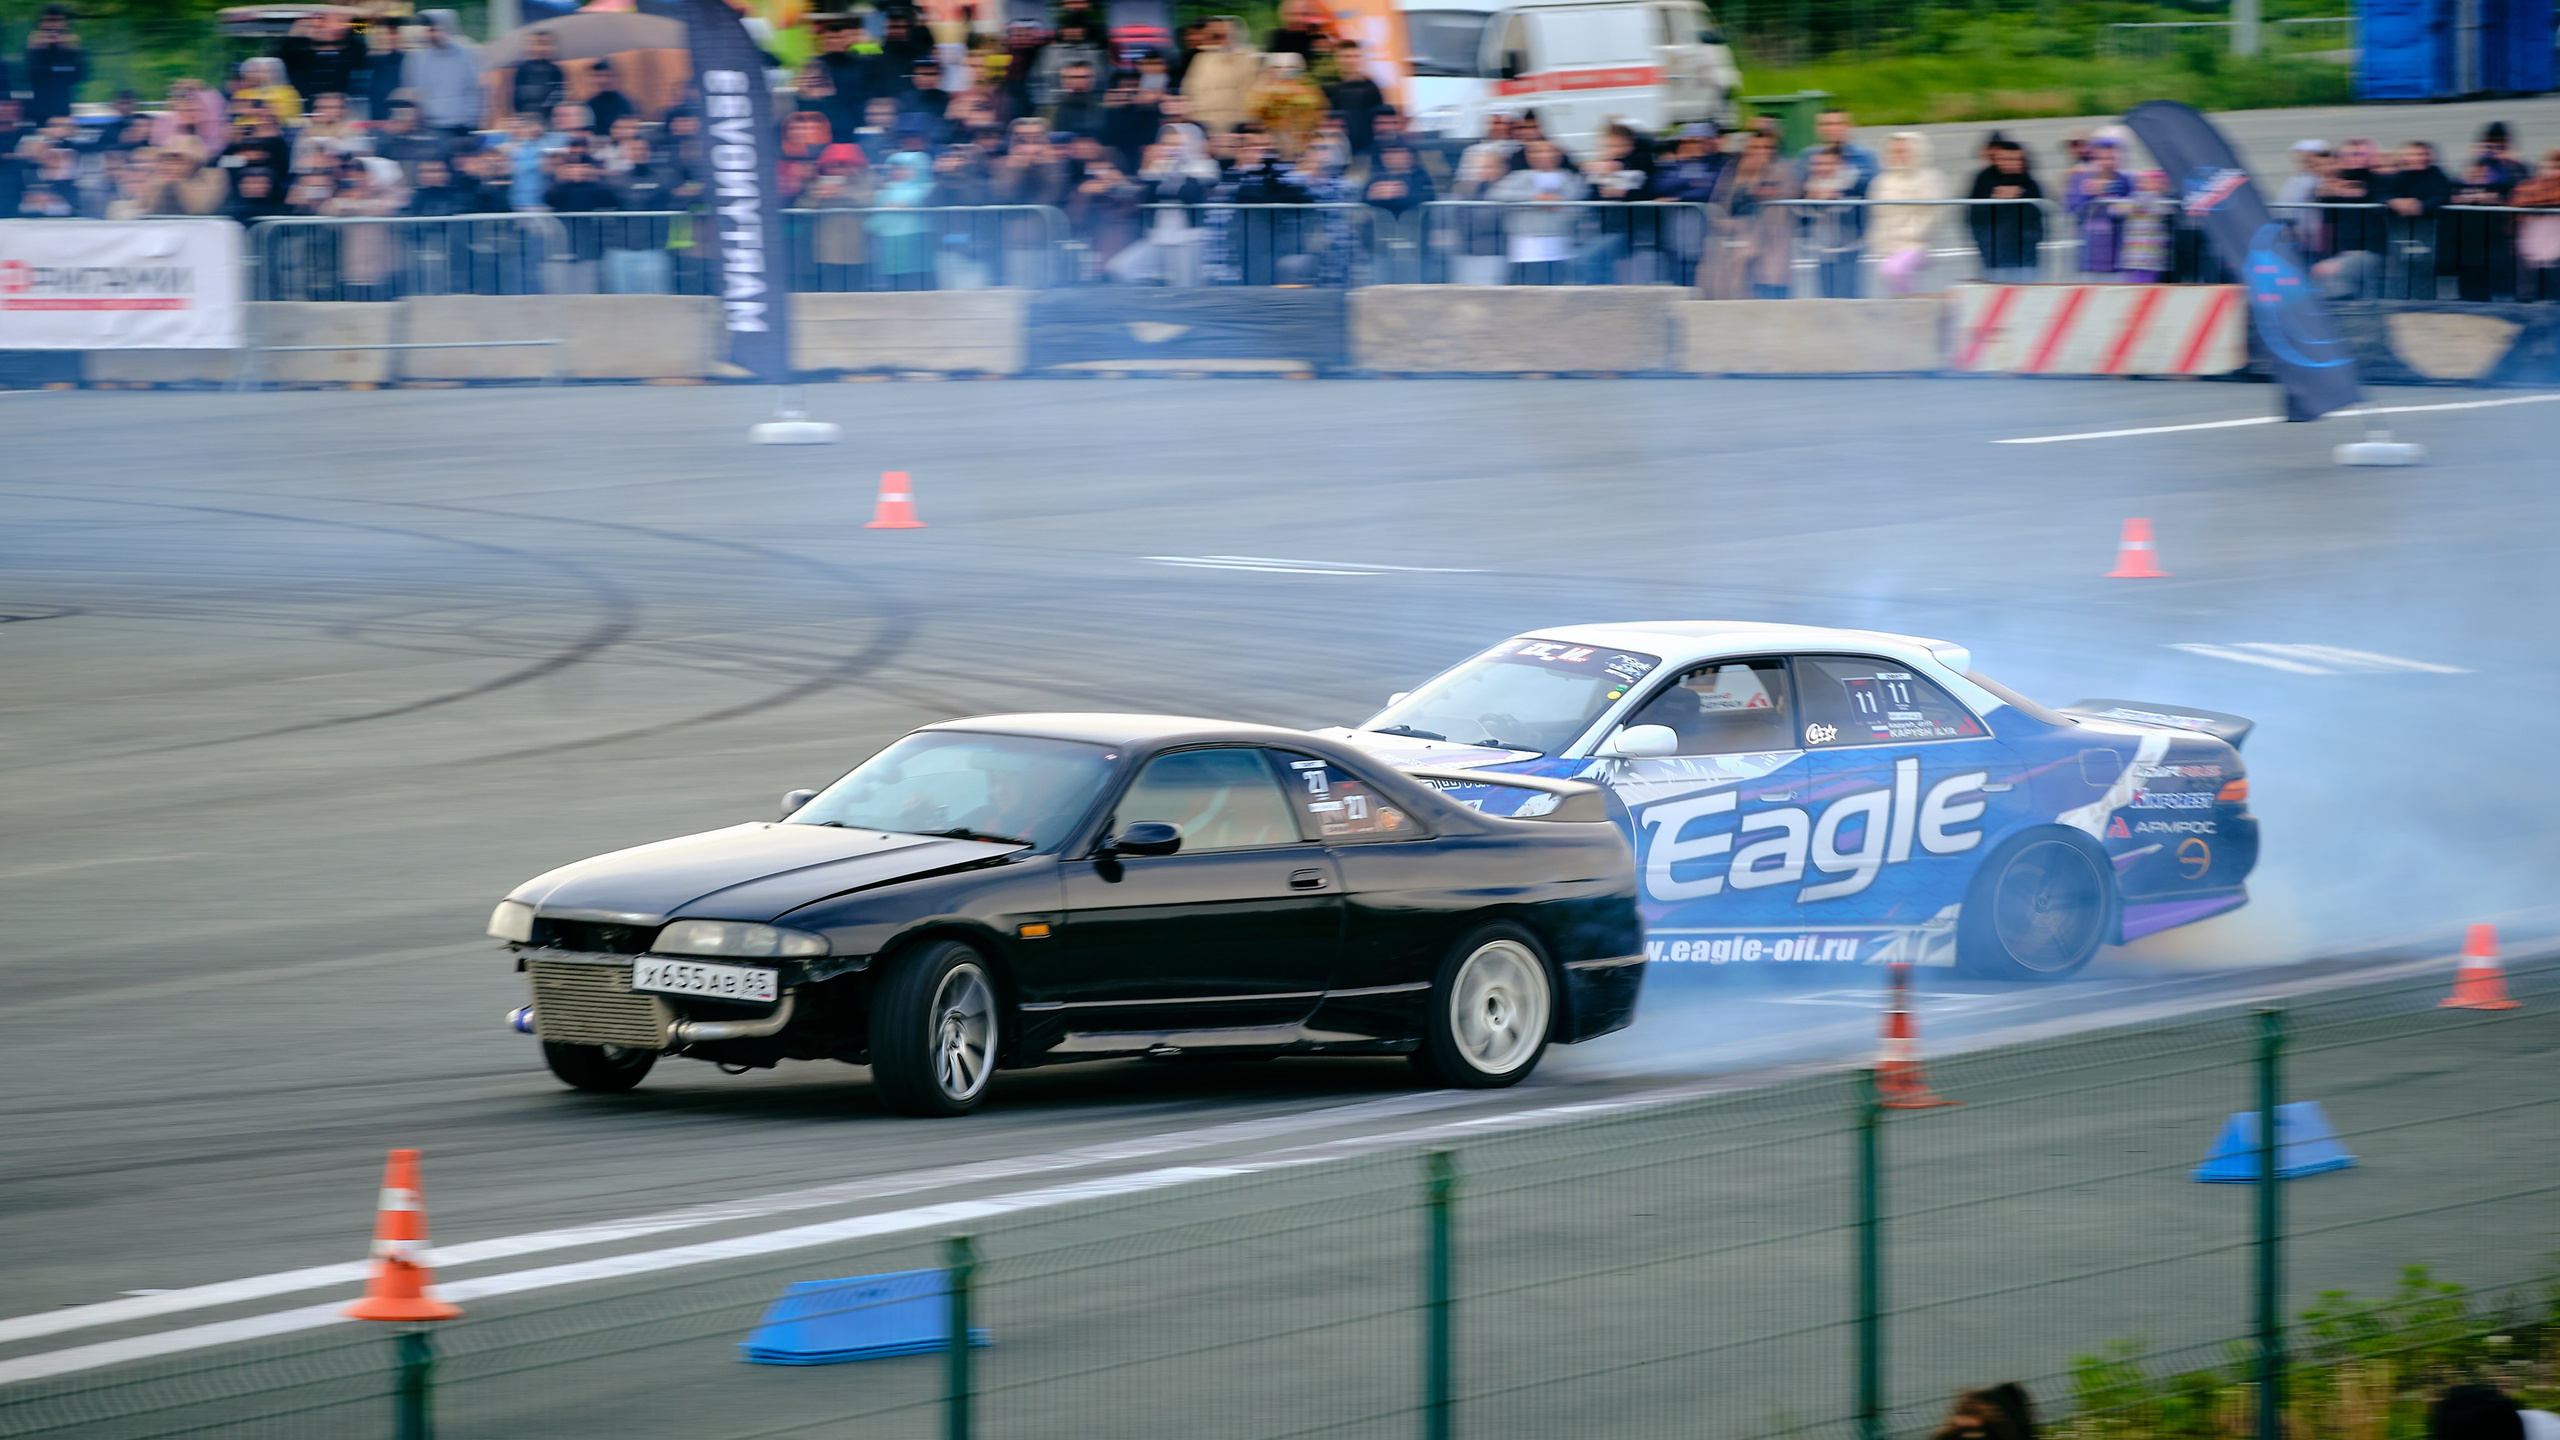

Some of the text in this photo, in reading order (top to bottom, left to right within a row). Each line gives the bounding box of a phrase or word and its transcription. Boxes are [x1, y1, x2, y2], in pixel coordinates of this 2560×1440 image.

[1855, 691, 1878, 714] 11
[1887, 682, 1911, 704] 11
[1641, 757, 1988, 903] Eagle
